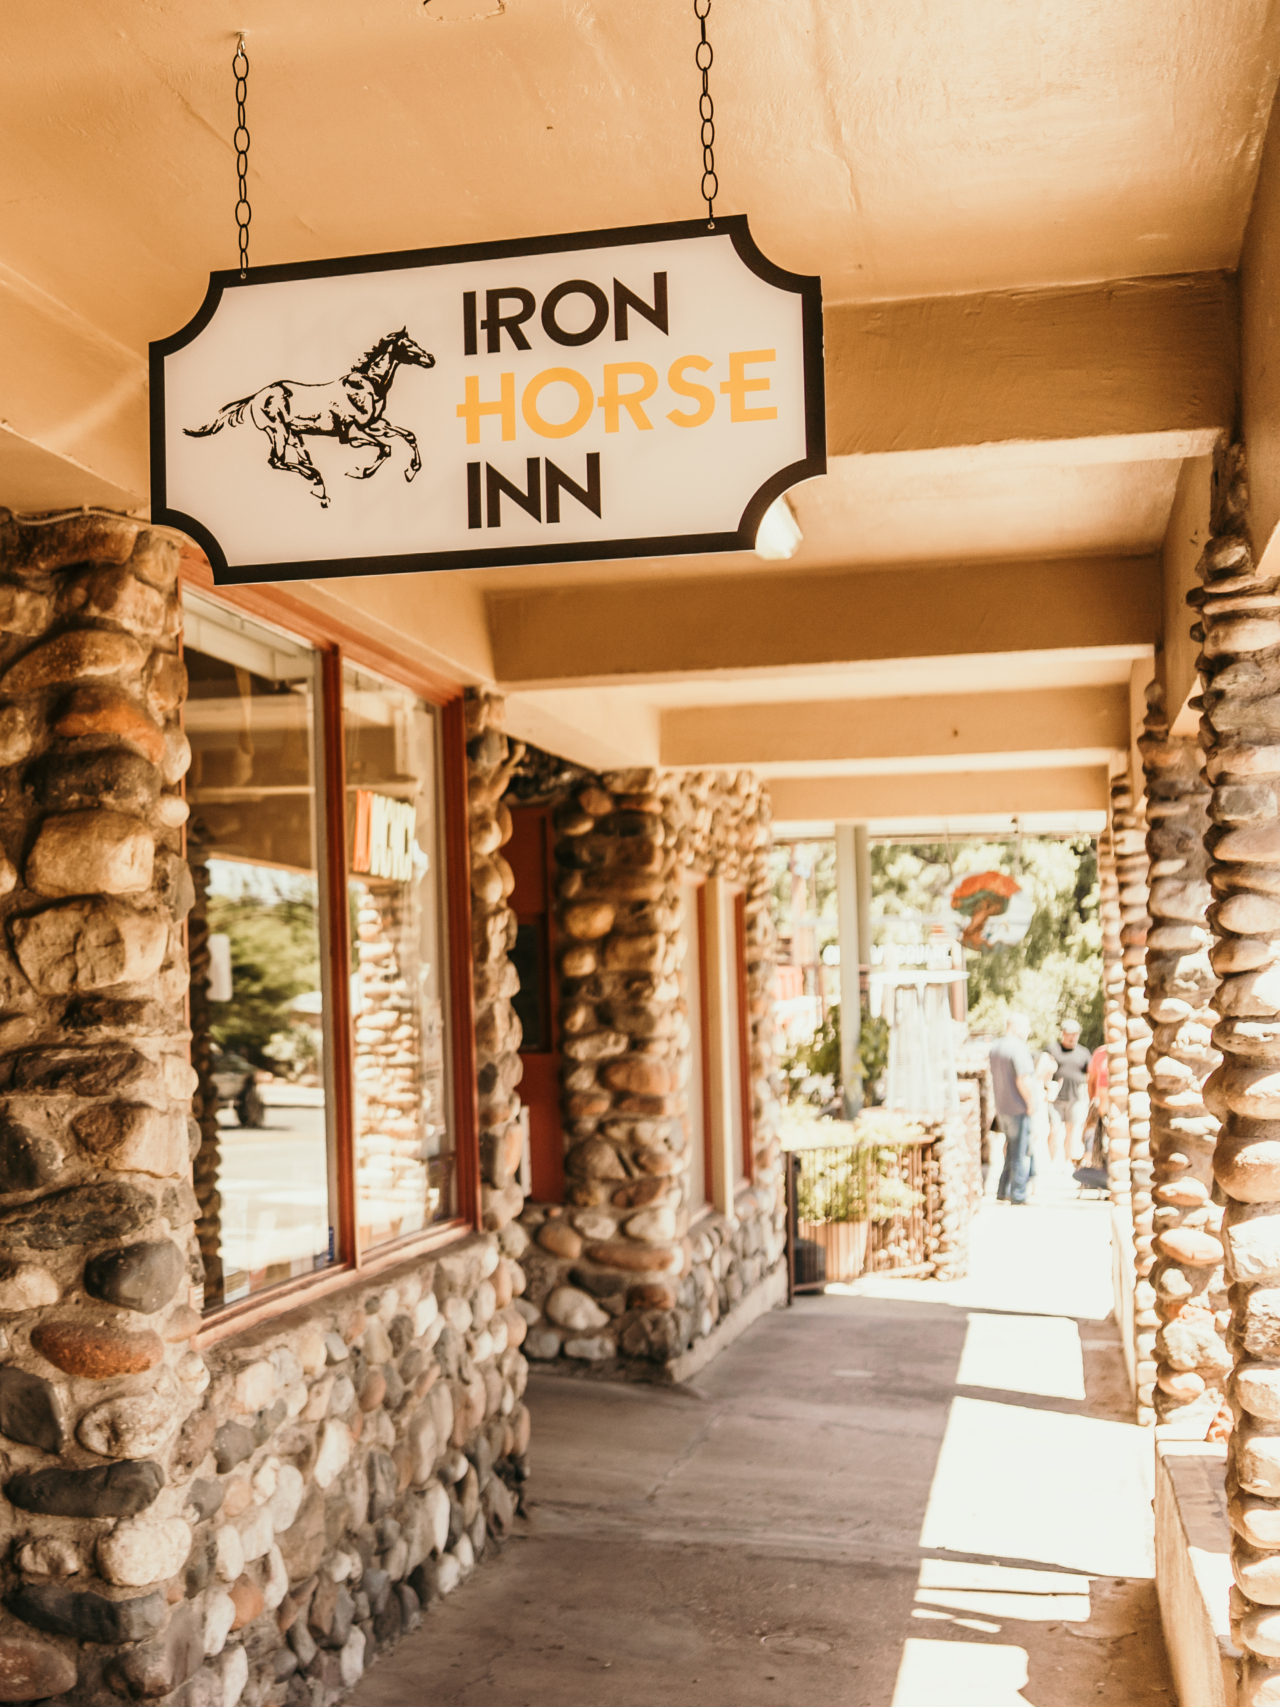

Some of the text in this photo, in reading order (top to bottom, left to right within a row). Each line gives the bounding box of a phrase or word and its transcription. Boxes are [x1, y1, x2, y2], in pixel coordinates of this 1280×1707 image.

[463, 271, 669, 356] IRON
[456, 348, 778, 444] HORSE
[467, 452, 602, 529] INN
